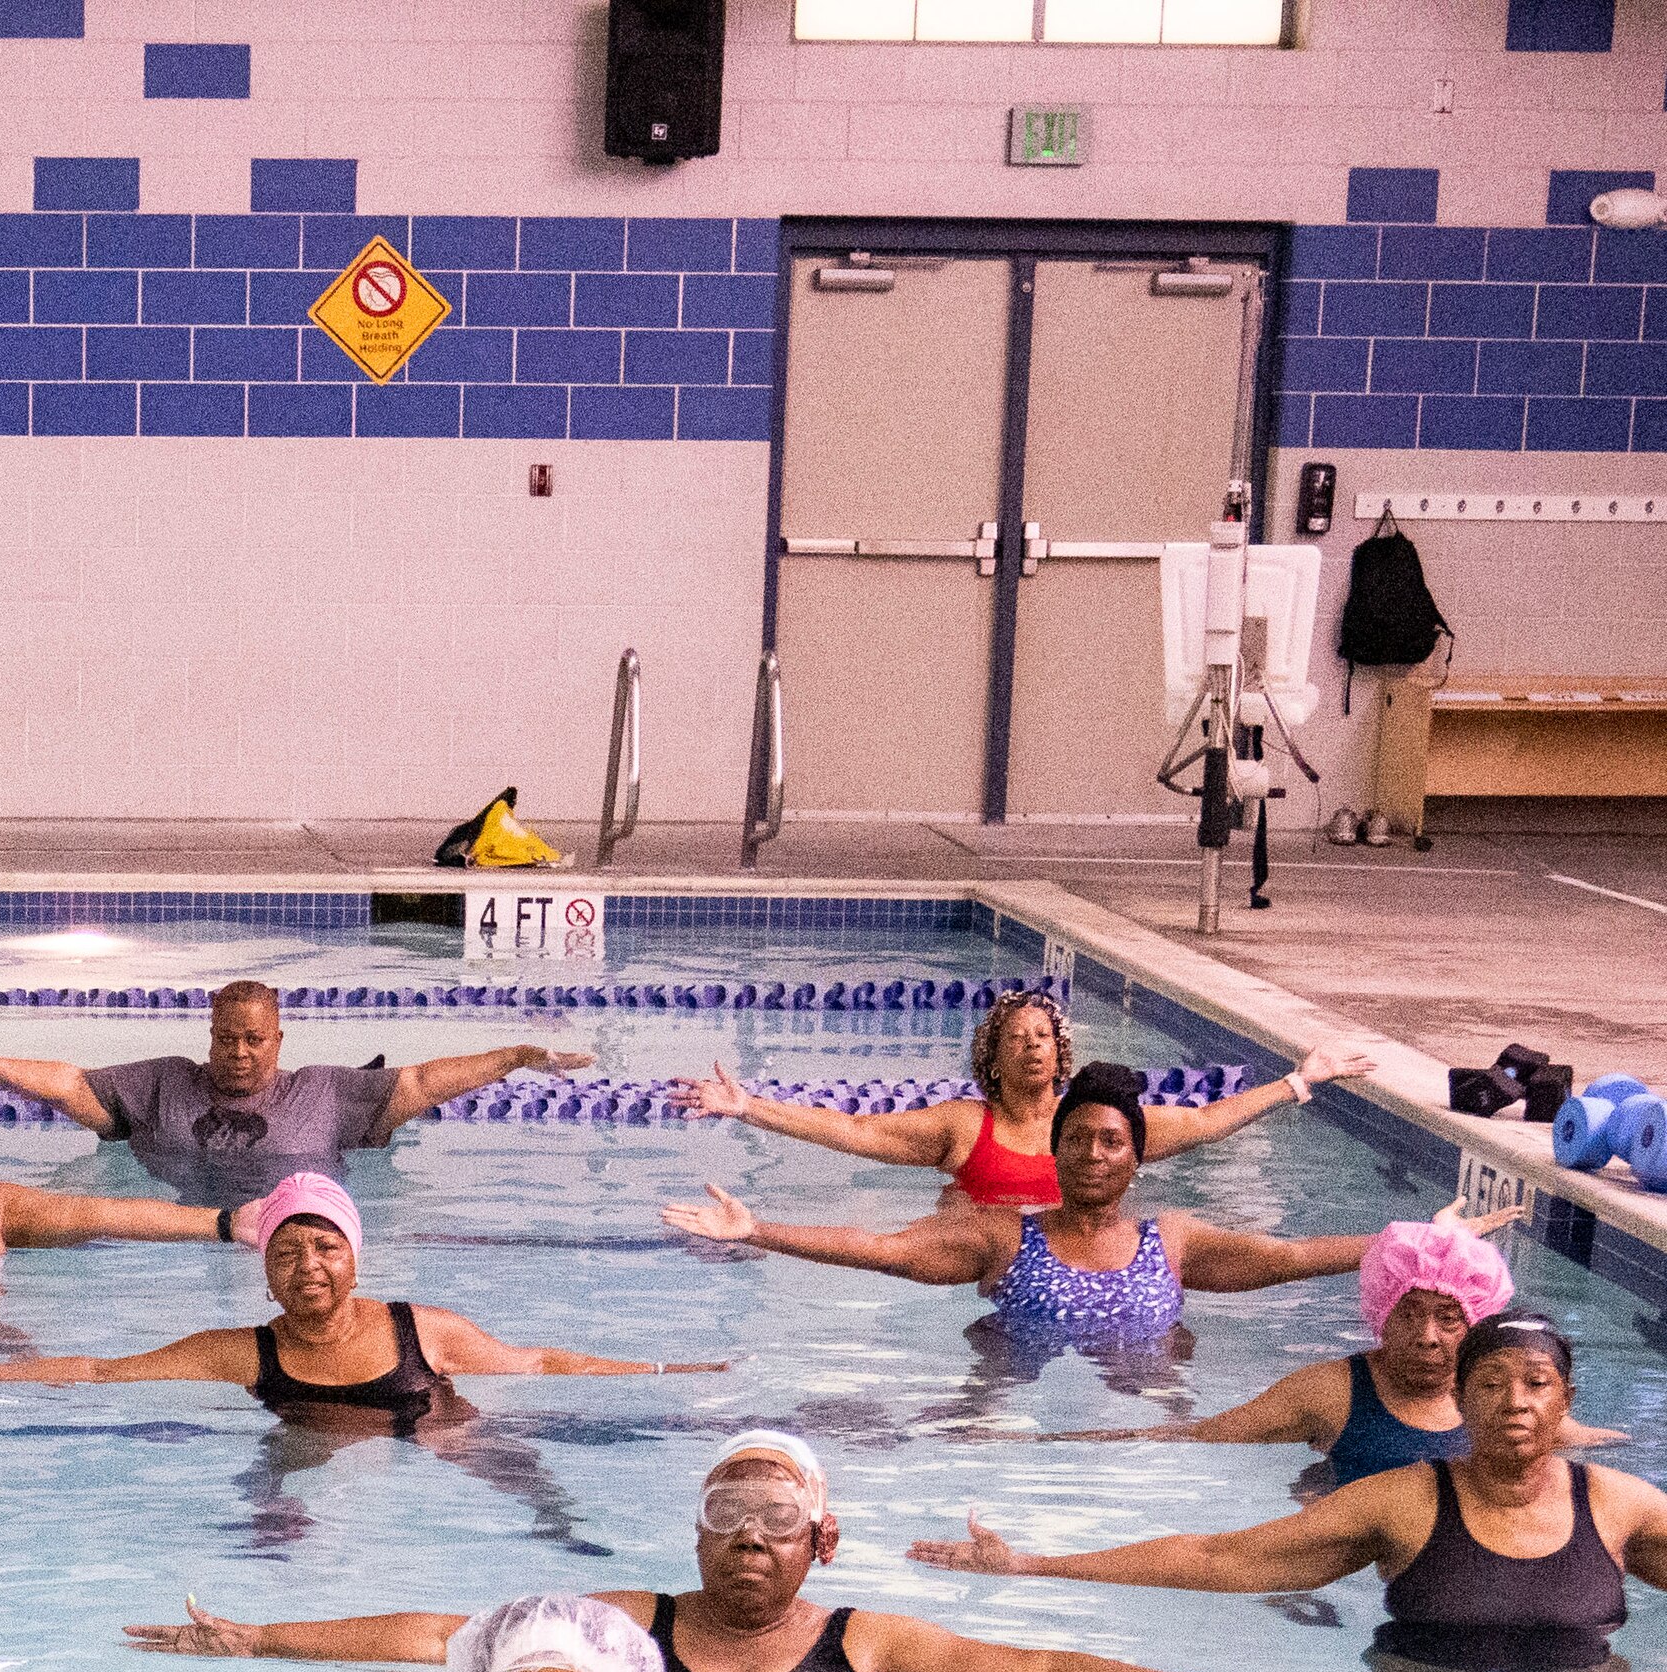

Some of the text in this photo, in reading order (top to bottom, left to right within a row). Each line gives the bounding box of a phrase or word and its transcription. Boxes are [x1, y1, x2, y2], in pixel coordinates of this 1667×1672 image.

[1024, 111, 1078, 159] EXIT
[357, 319, 404, 330] No Long
[362, 331, 399, 341] Breath
[359, 343, 402, 354] Holding
[480, 897, 553, 948] 4 FT
[1476, 1164, 1497, 1216] FT
